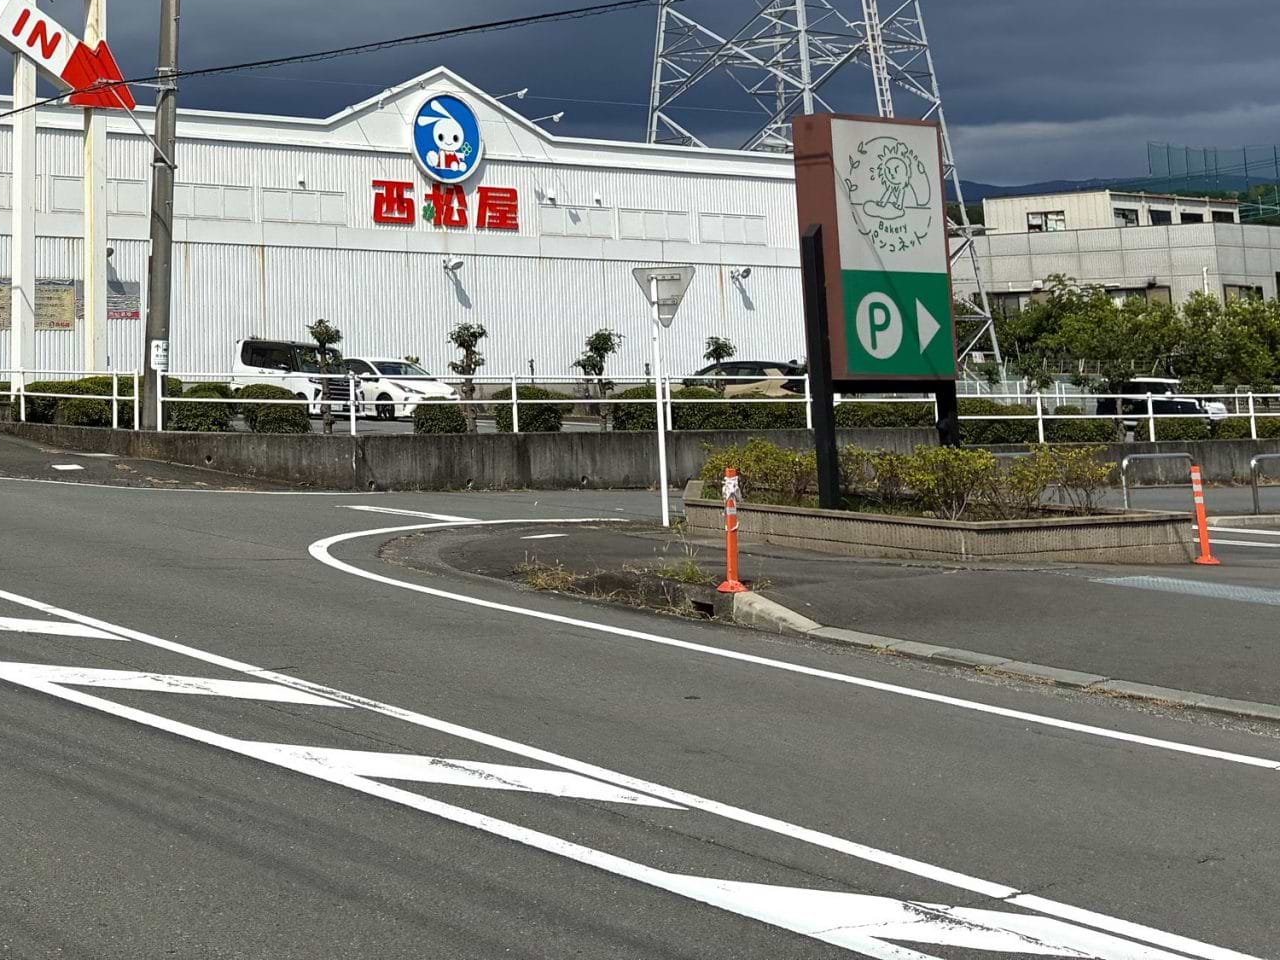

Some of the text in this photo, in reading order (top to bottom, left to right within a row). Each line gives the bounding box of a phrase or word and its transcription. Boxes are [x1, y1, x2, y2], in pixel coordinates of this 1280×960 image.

[11, 8, 62, 60] IN
[372, 179, 520, 230] 西松屋
[878, 220, 908, 234] Bakery
[868, 301, 891, 350] P
